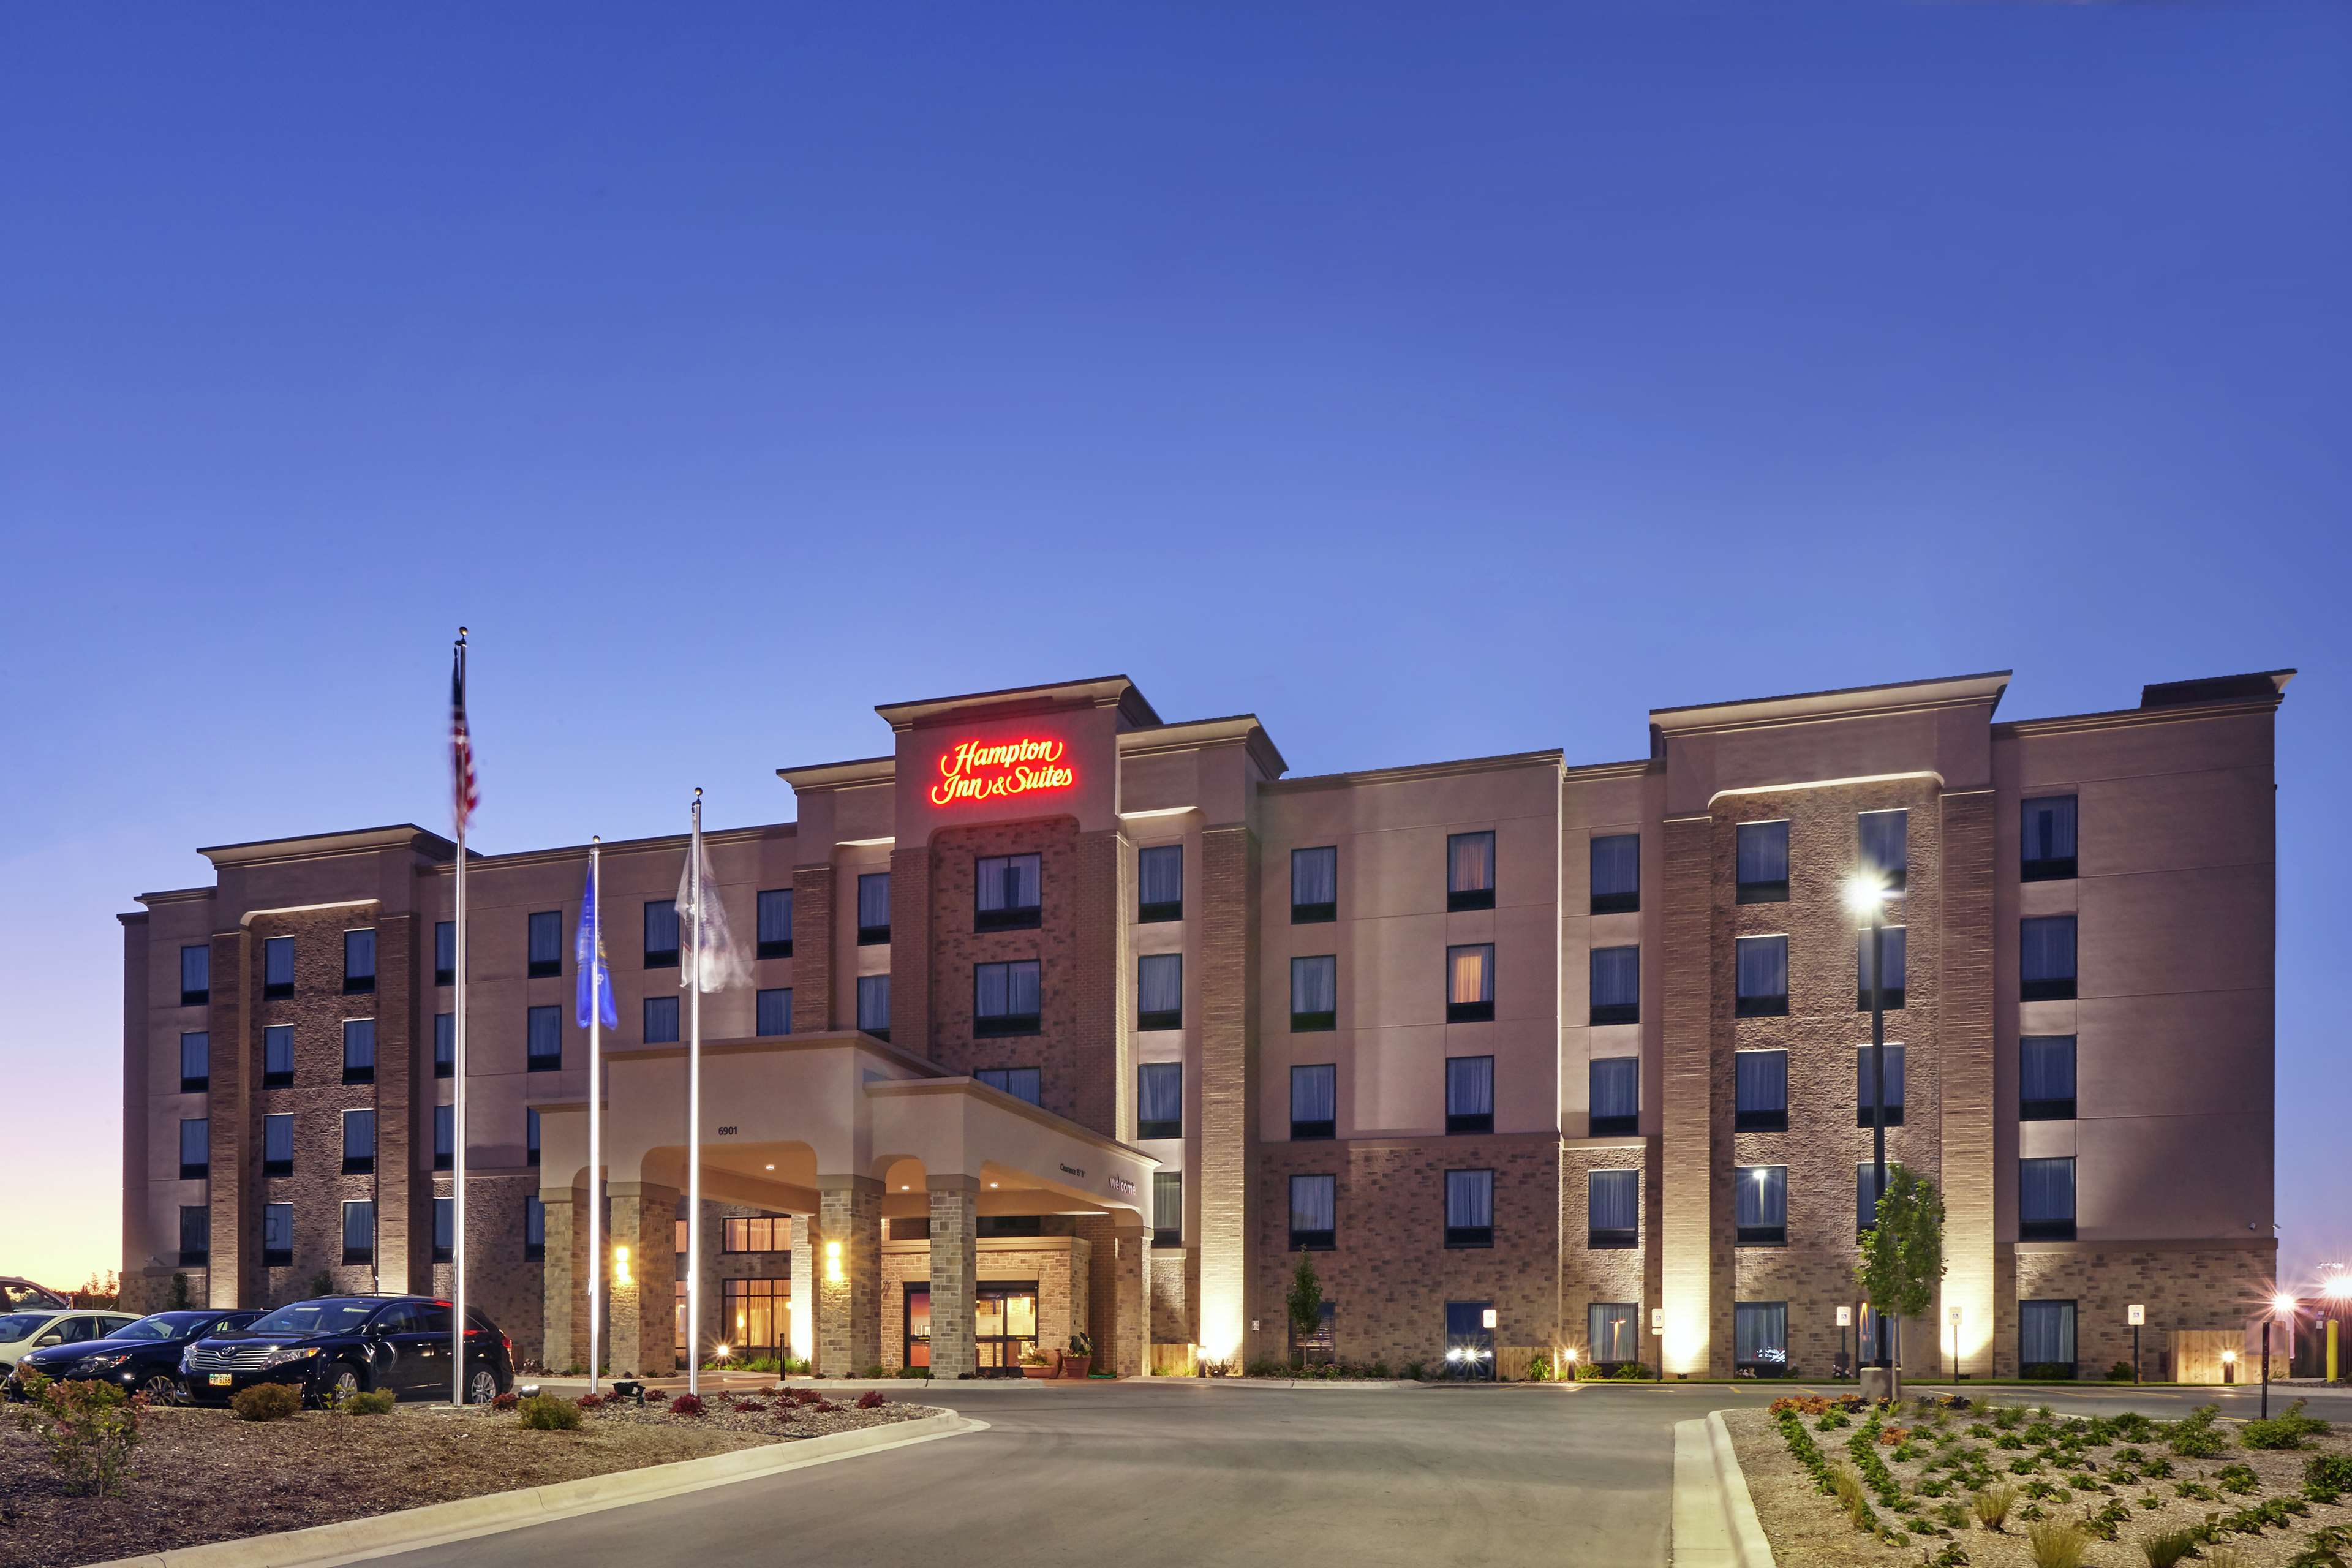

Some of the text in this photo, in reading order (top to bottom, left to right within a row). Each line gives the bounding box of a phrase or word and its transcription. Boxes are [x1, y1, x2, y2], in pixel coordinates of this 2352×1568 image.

[941, 739, 1063, 777] Hampton
[931, 765, 1073, 804] Inn & Suites
[718, 1126, 737, 1135] 6901
[1109, 1175, 1136, 1196] welcome
